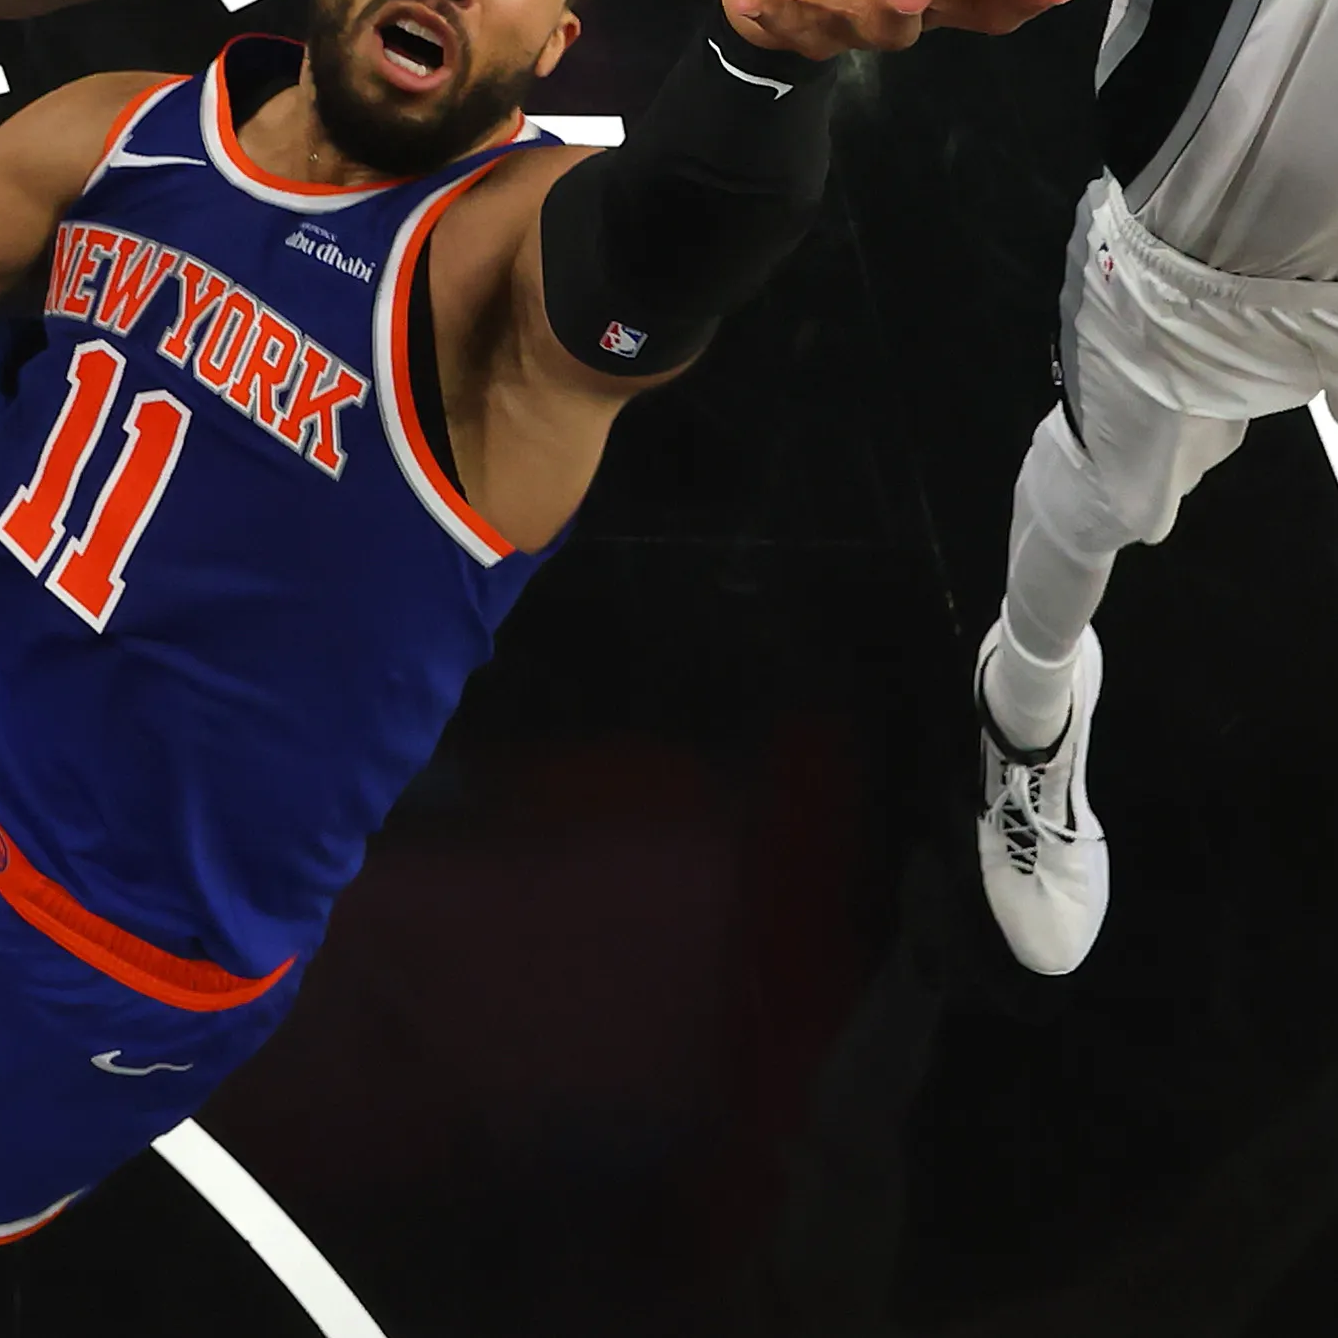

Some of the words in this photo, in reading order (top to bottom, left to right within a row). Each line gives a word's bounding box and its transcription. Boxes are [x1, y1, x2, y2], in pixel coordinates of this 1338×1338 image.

[315, 243, 377, 283] dhabi
[44, 221, 179, 338] NEW
[156, 254, 372, 482] YORK
